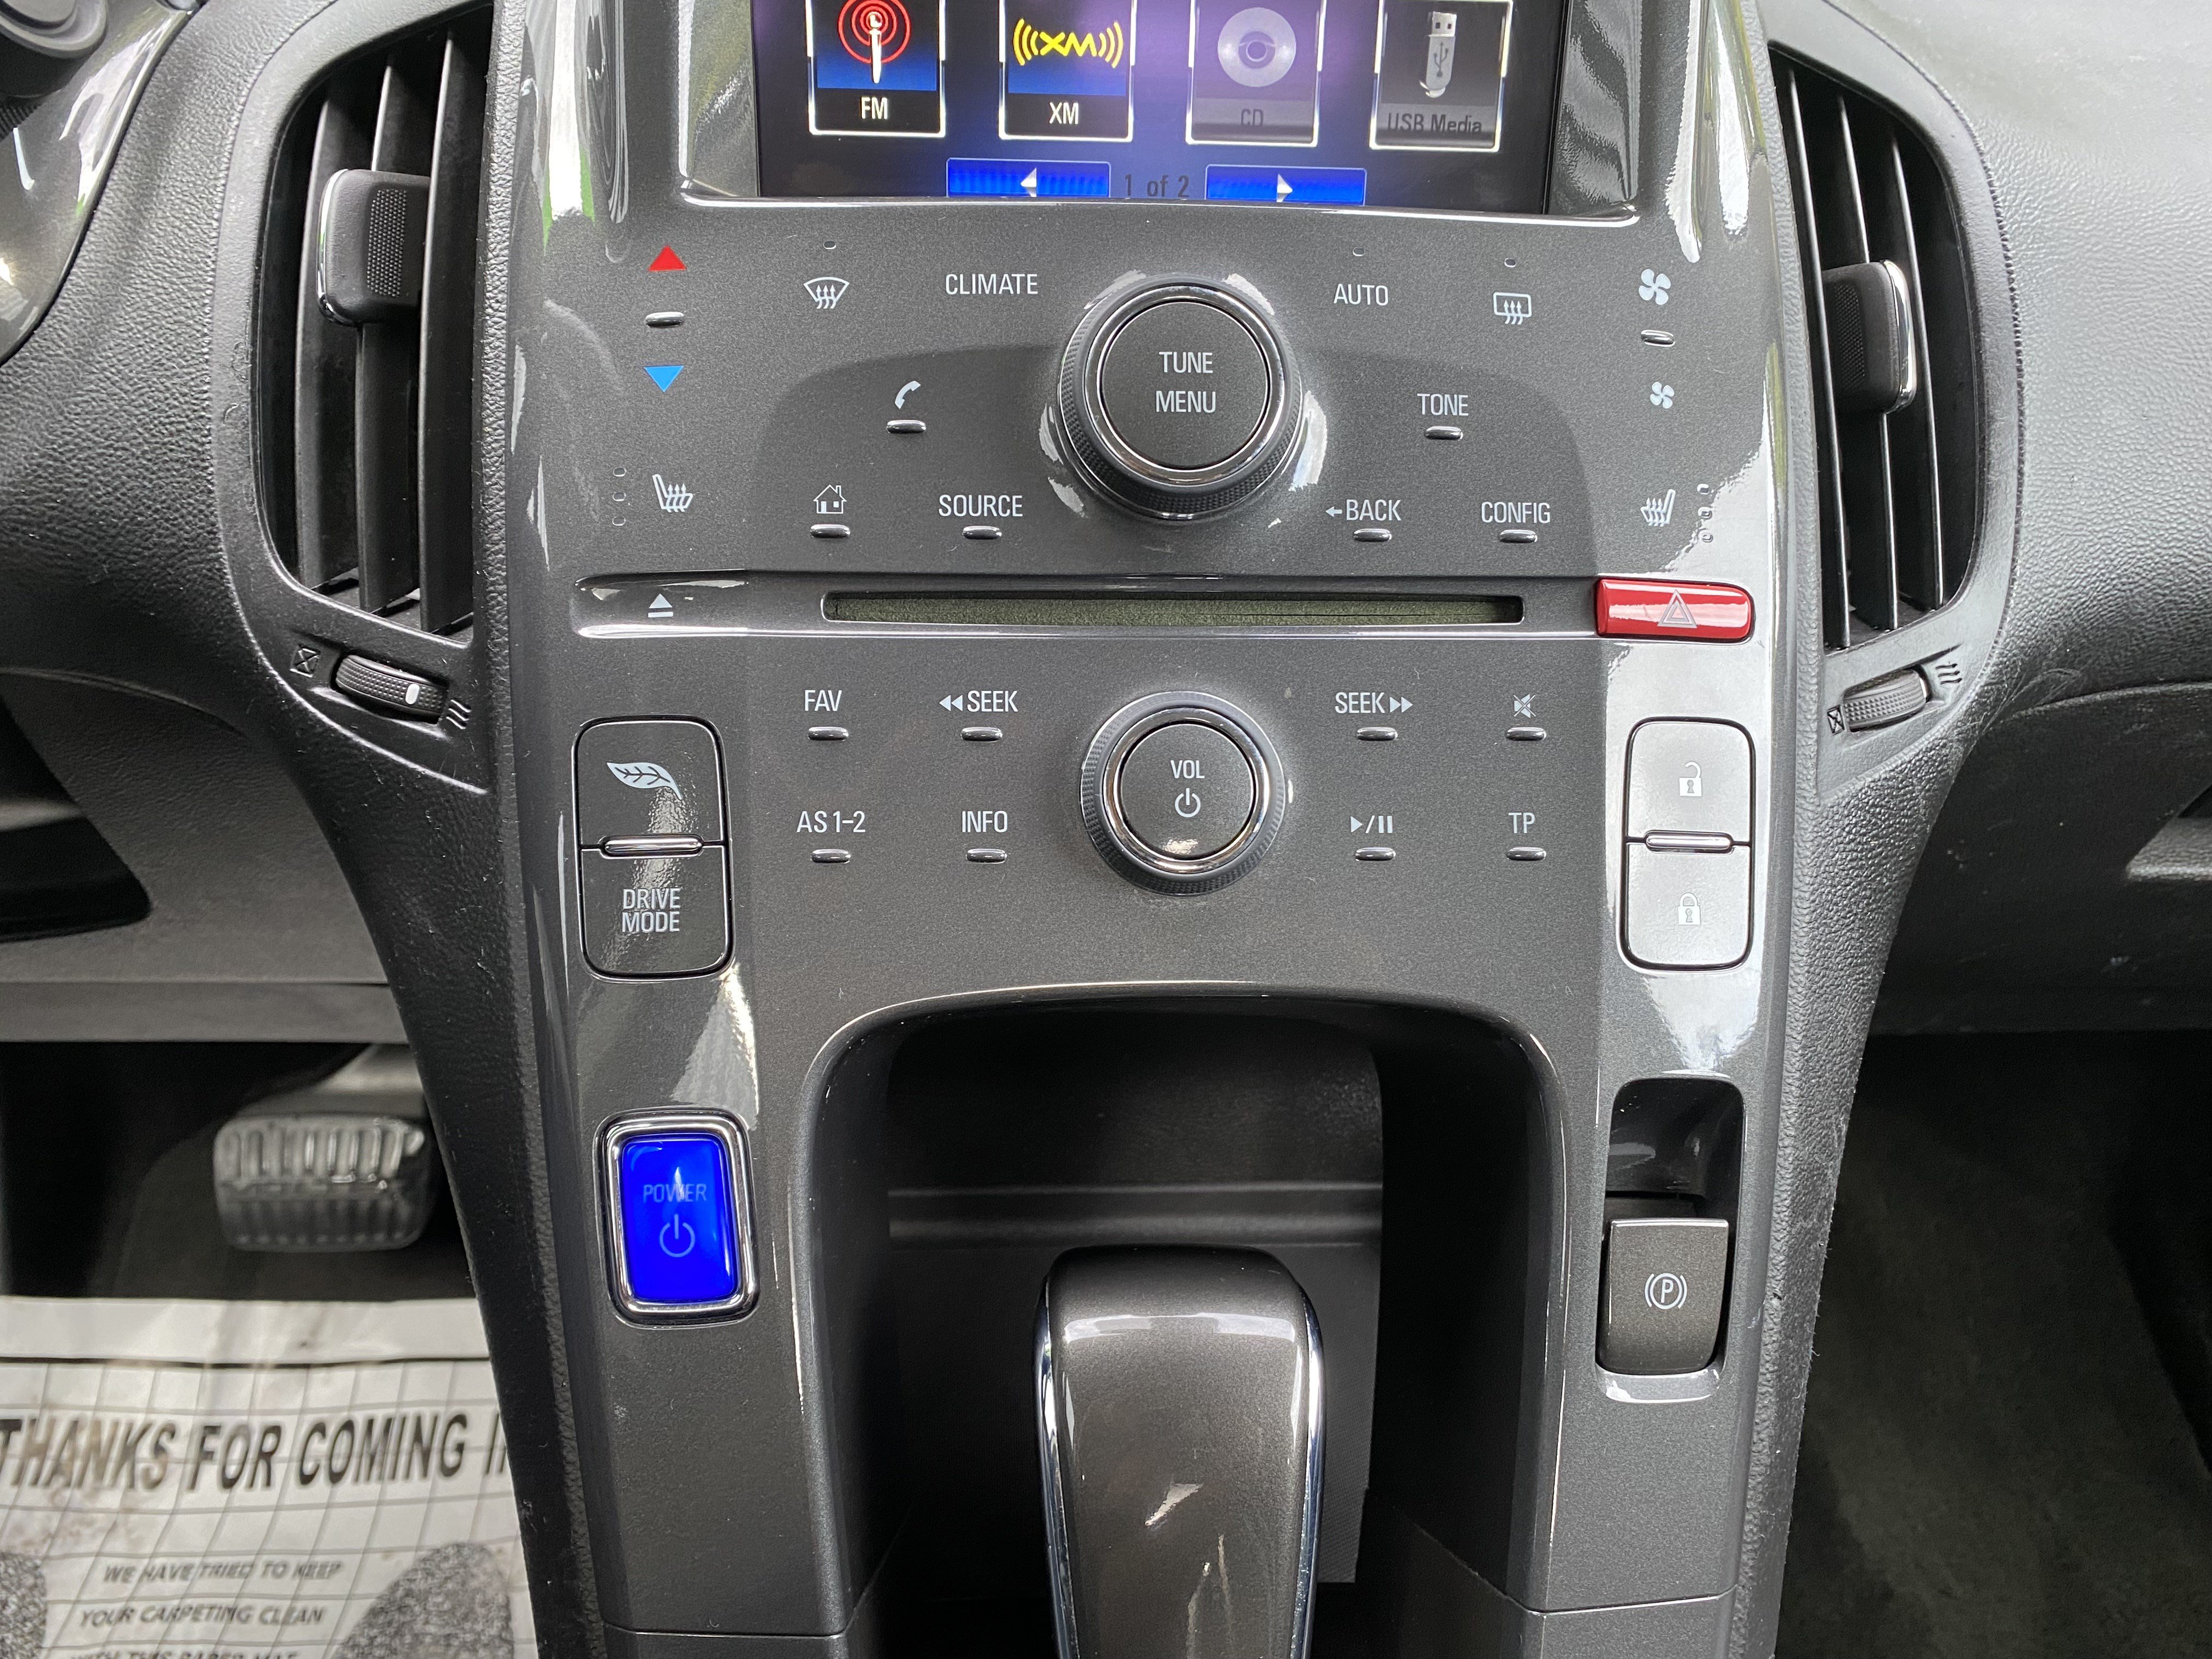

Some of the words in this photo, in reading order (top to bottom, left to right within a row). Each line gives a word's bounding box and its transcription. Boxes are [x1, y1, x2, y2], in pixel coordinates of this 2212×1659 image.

[861, 97, 888, 120] FM
[1049, 102, 1079, 125] XM
[1240, 109, 1263, 126] CD
[1387, 112, 1424, 132] USB
[1430, 114, 1482, 133] Media
[1125, 174, 1132, 196] 1
[1146, 174, 1170, 197] of
[1177, 175, 1189, 198] 2
[945, 273, 1039, 295] CLIMATE
[1333, 283, 1389, 306] AUTO
[1159, 351, 1214, 374] TUNE
[1156, 390, 1216, 413] MENU
[1417, 393, 1469, 416] TONE
[939, 494, 1023, 517] SOURCE
[1346, 499, 1402, 521] BACK
[1481, 501, 1550, 524] CONFIG
[804, 690, 842, 712] FAV
[967, 690, 1018, 712] SEEK
[1335, 692, 1386, 714] SEEK
[1170, 759, 1205, 779] VOL
[962, 810, 1008, 833] INFO
[1508, 812, 1536, 834] TP
[622, 888, 681, 910] DRIVE
[622, 911, 680, 933] MODE
[642, 1183, 707, 1203] POWER
[1661, 1279, 1674, 1304] P
[188, 1424, 283, 1490] FOR
[298, 1414, 468, 1485] COMING
[105, 1566, 135, 1583] WE
[141, 1564, 193, 1582] HAVE
[199, 1561, 255, 1580] TRIED
[261, 1561, 286, 1579] TO
[292, 1560, 342, 1579] KEEP
[81, 1606, 133, 1627] YOUR
[139, 1604, 254, 1625] CARPETING
[259, 1605, 326, 1626] CLEAN
